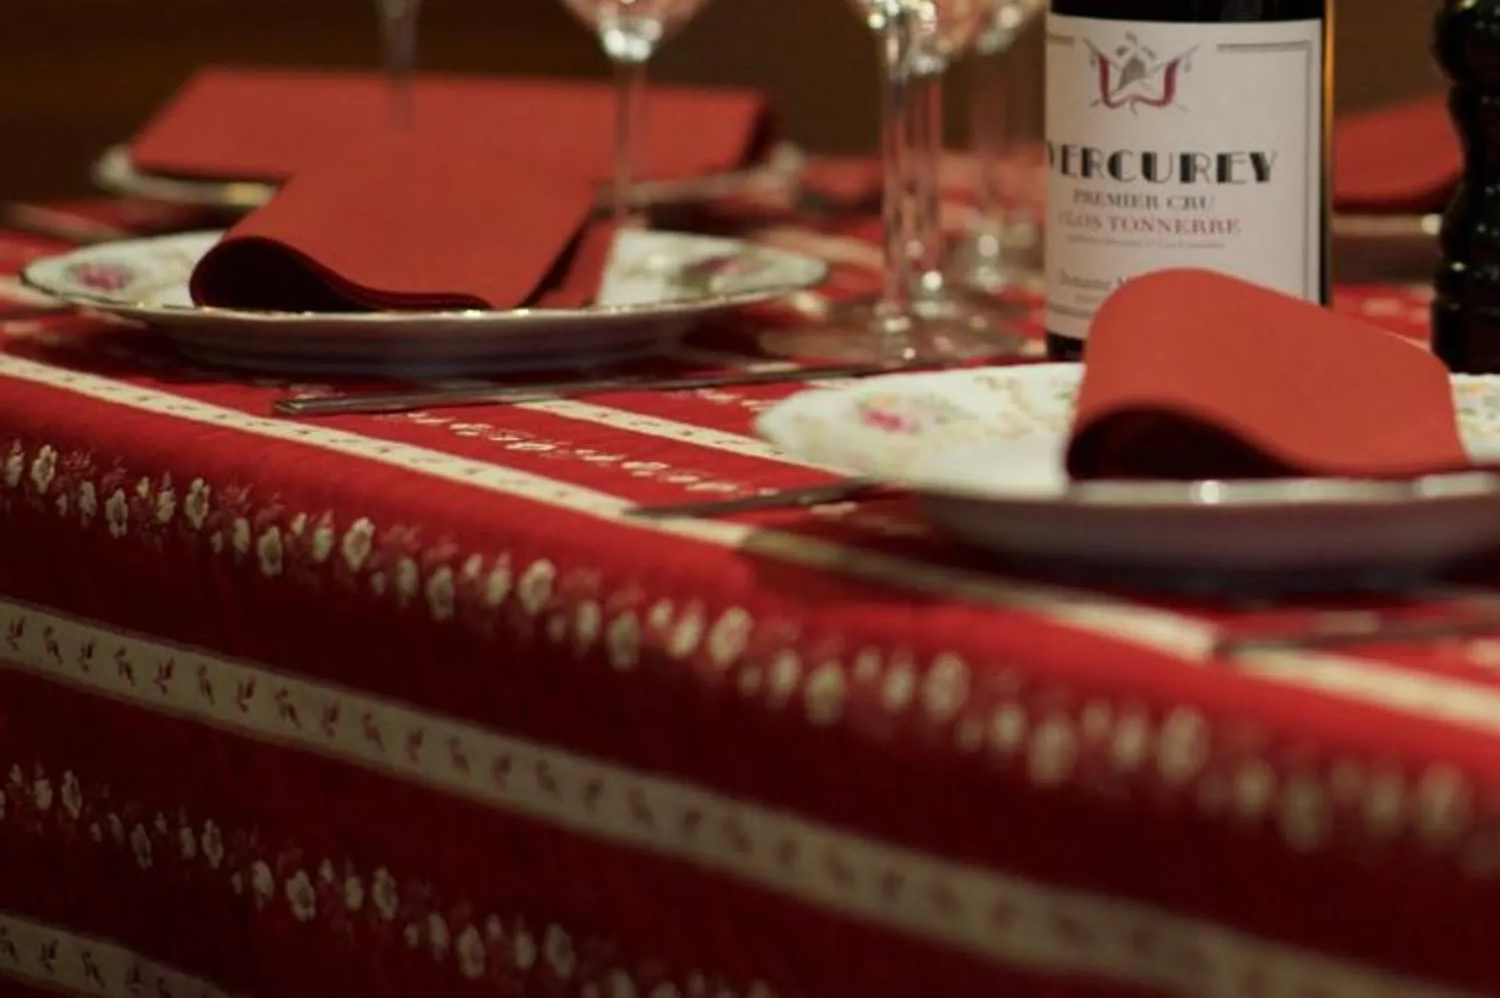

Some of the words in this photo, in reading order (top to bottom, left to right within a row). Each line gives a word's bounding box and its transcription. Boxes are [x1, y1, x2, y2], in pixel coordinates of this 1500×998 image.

[1073, 188, 1158, 211] PREMIER
[1166, 194, 1216, 212] CRU
[1107, 215, 1243, 235] TONNERRE
